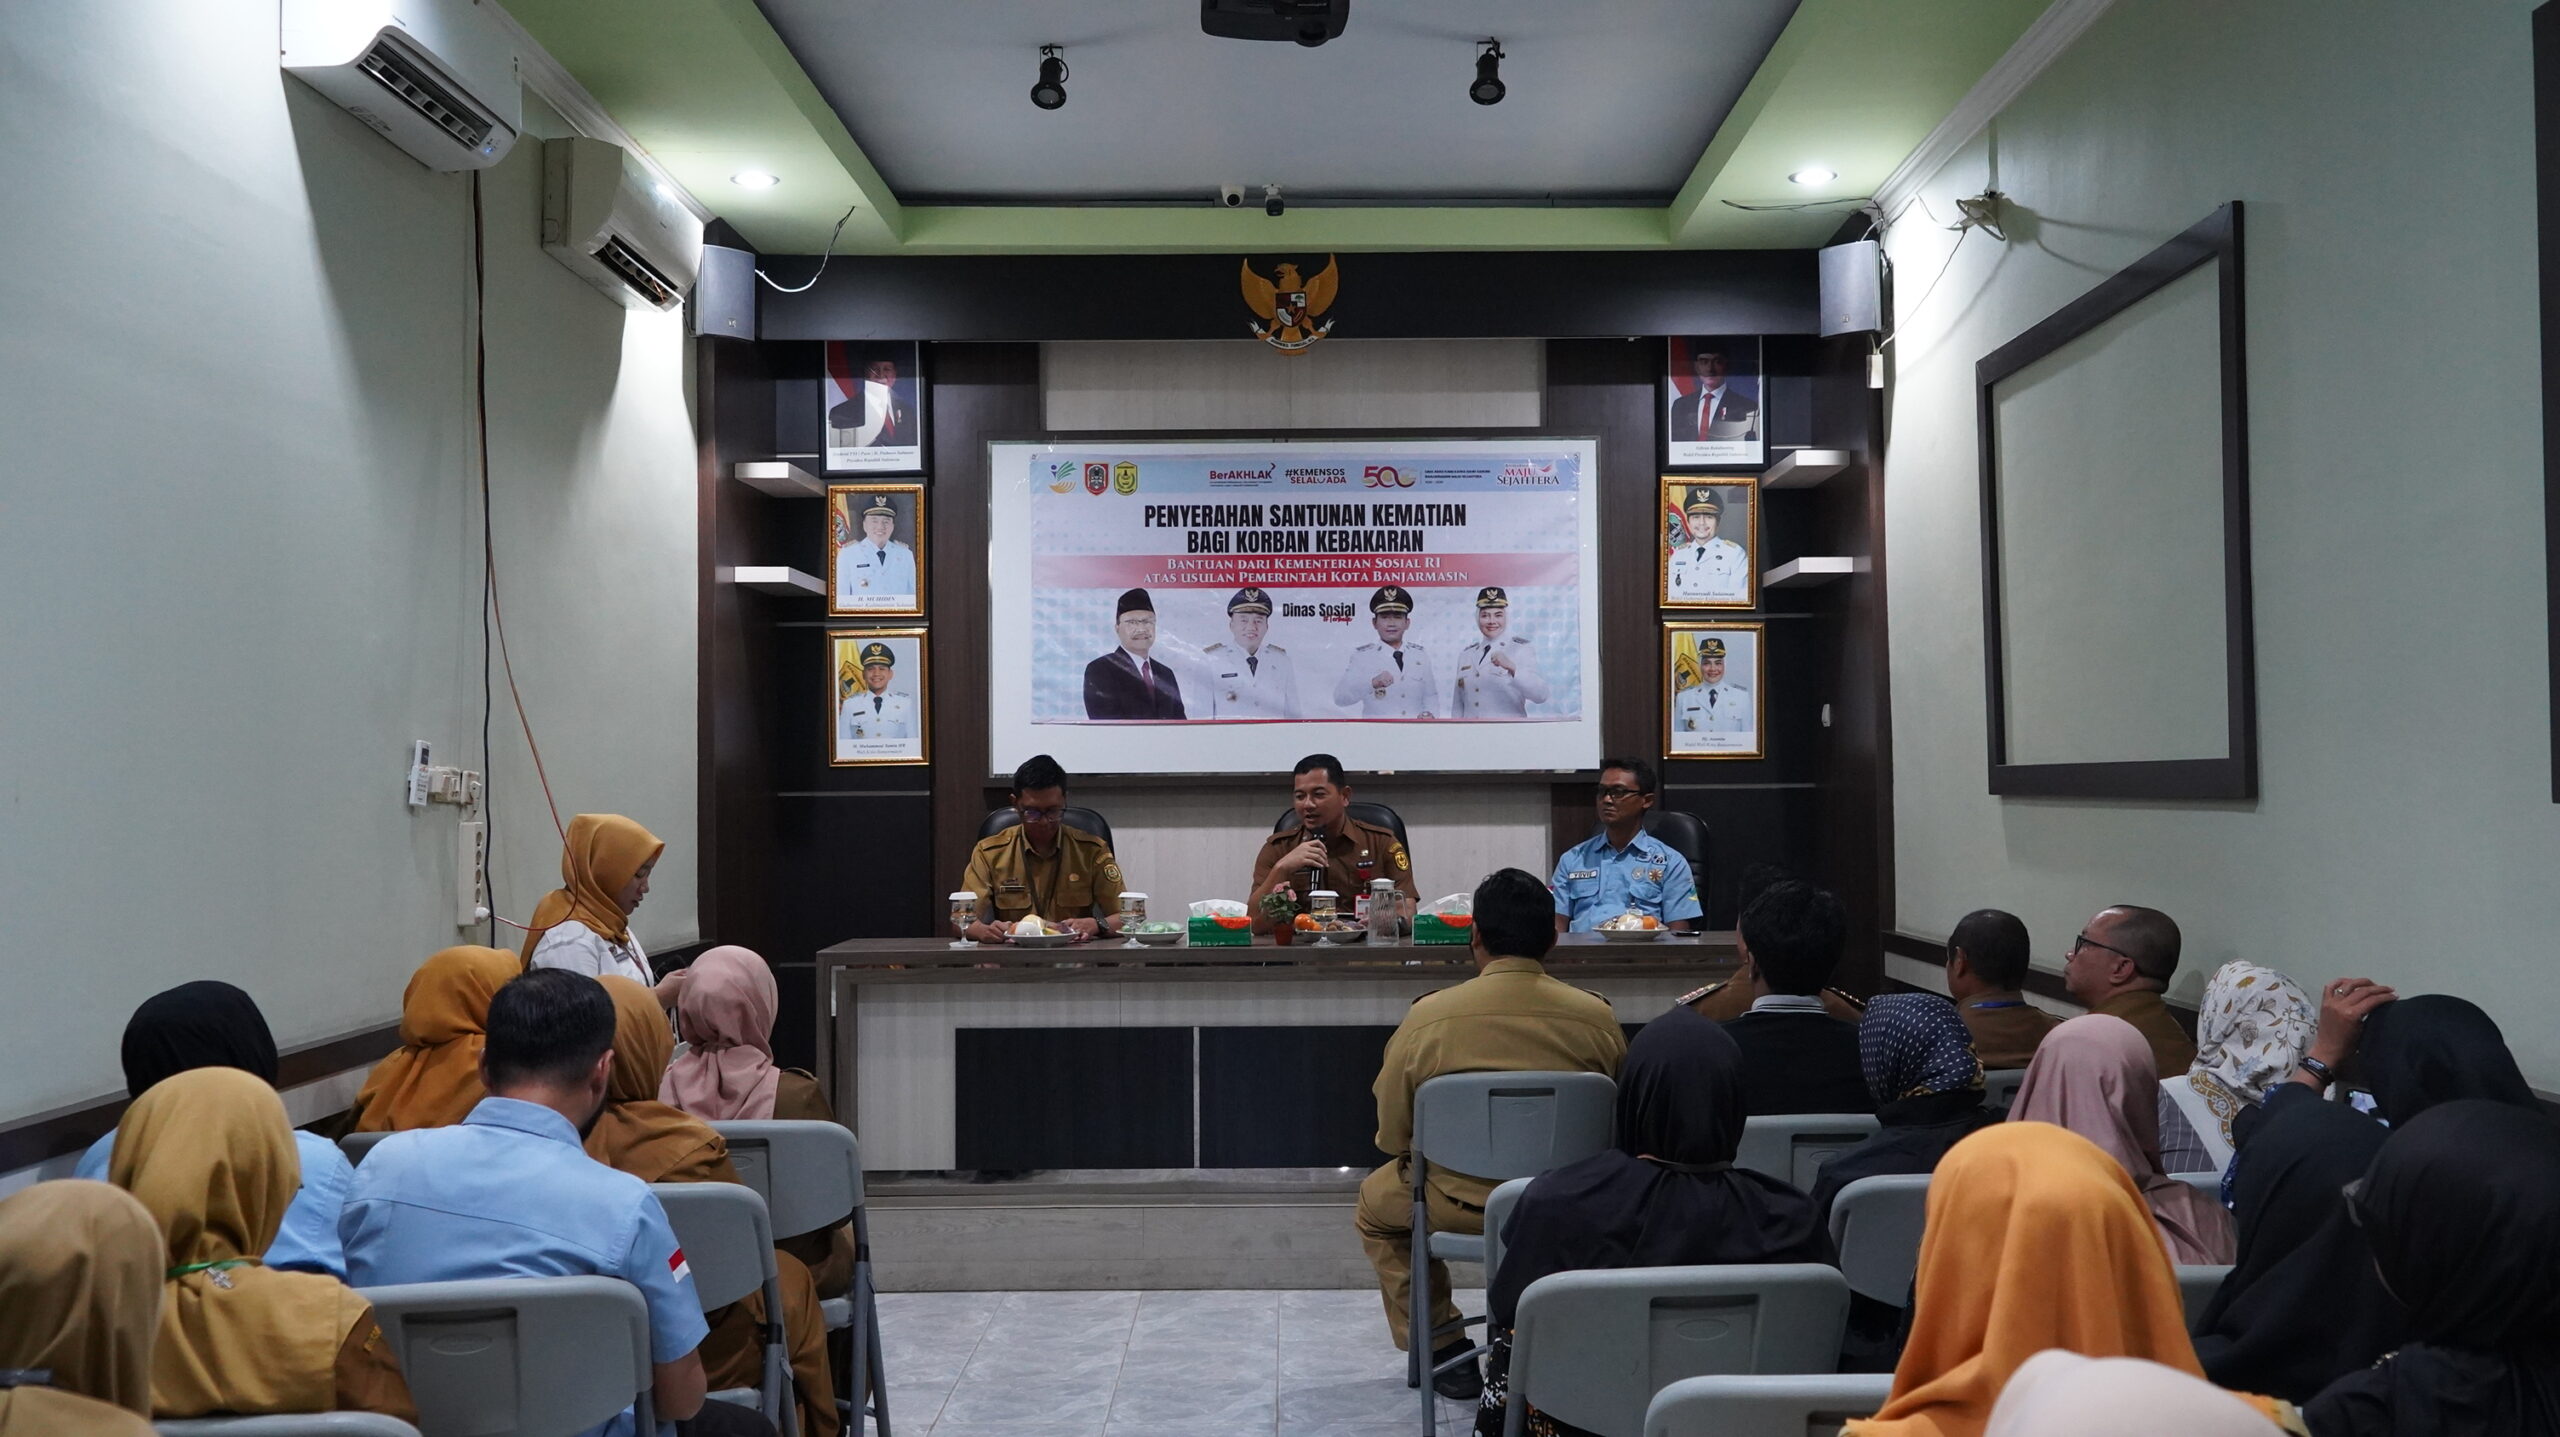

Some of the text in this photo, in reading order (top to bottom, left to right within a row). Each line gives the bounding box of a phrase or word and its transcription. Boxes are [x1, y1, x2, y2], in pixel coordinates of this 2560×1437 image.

[1209, 465, 1275, 480] BerAKHLAK
[1285, 468, 1345, 477] #KEMENSOS
[1505, 468, 1536, 477] MAJU
[1144, 504, 1467, 528] PENYERAHAN SANTUNAN KEMATIAN
[1187, 530, 1424, 554] BAGI KORBAN KEBAKARAN
[1167, 557, 1441, 570] BANTUAN DARI KEMENTERIAN SOSIAL RI
[1143, 571, 1468, 583] ATAS USULAN PEMERINTAH KOTA BANJARMASIN
[1283, 602, 1356, 617] Dinas Sosial
